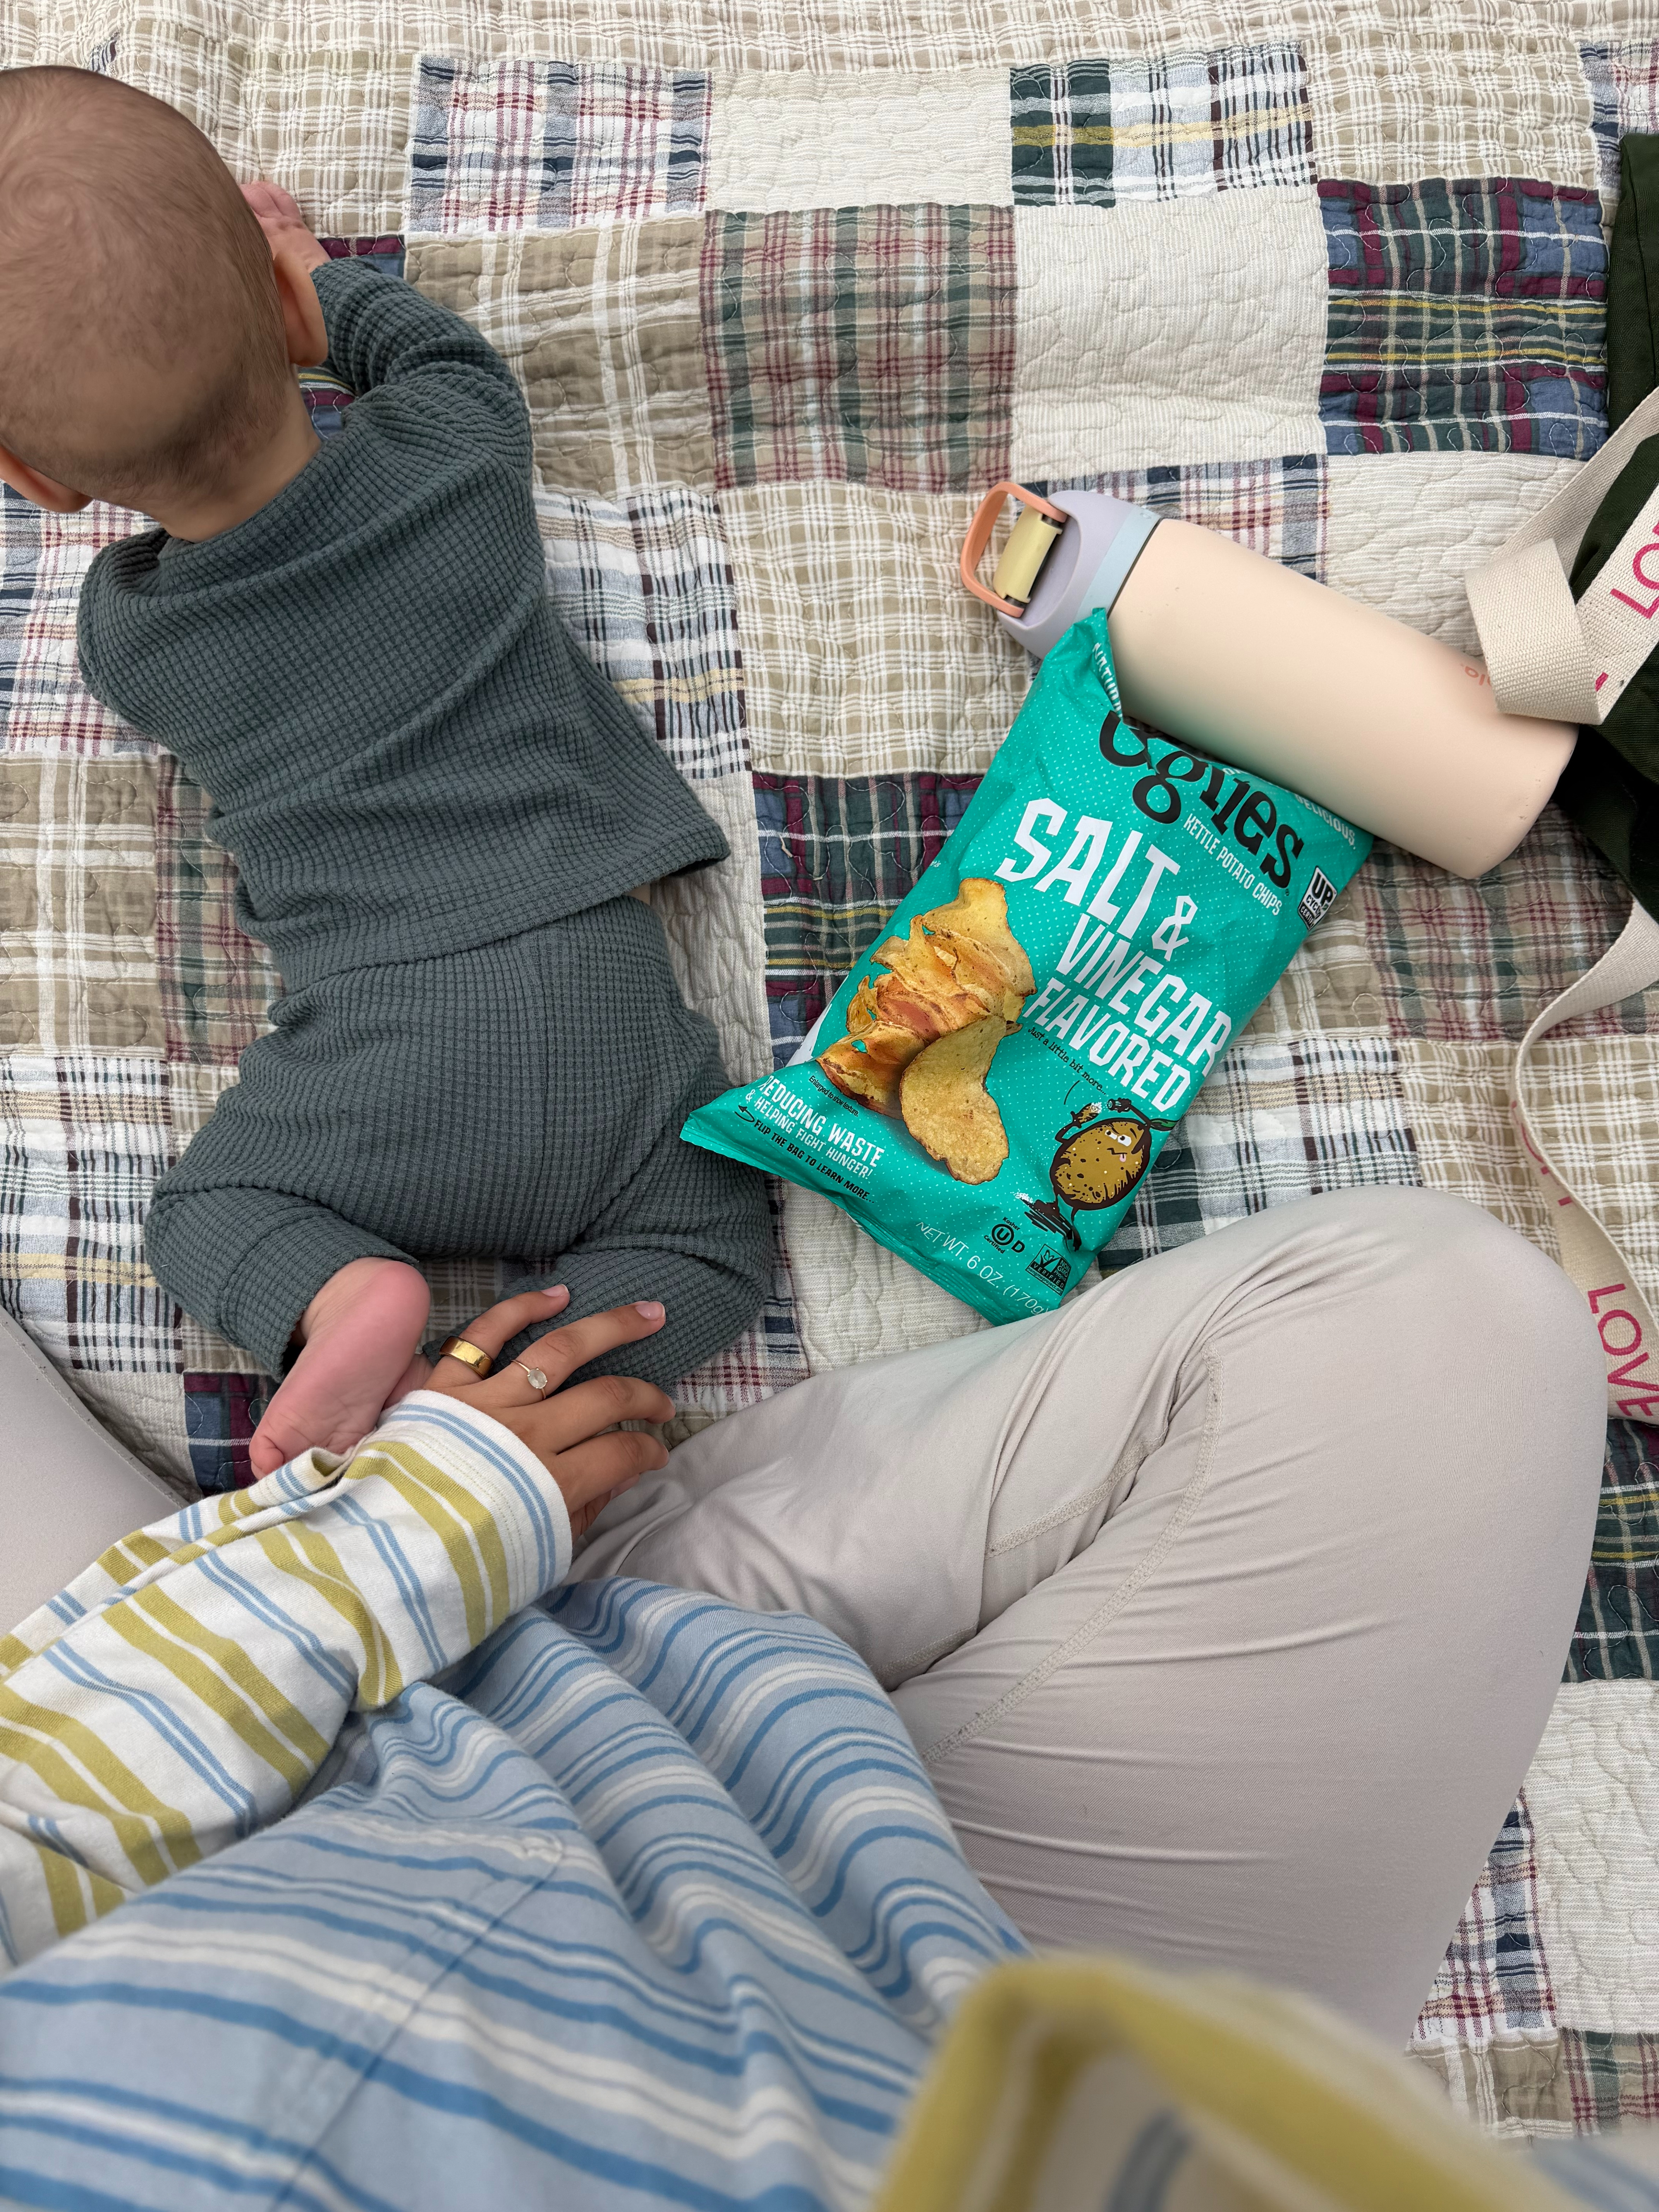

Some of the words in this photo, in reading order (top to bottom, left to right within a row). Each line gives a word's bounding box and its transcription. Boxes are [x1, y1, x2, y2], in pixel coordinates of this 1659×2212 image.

[994, 798, 1180, 939] SALT
[1151, 895, 1198, 961] &
[1183, 813, 1221, 855] KETTLE
[1216, 846, 1255, 890] POTATO
[1252, 882, 1283, 916] CHIPS
[1312, 872, 1333, 907] UP
[1056, 914, 1231, 1077] VINEGAR
[1022, 978, 1190, 1112] FLAVORED
[1028, 1027, 1045, 1041] Just
[1048, 1042, 1069, 1063] little
[1069, 1059, 1084, 1073] bit
[1081, 1071, 1106, 1095] more...
[809, 1075, 830, 1095] Enlarged
[833, 1096, 844, 1106] show
[842, 1102, 859, 1117] texture.
[745, 1089, 756, 1102] &
[754, 1096, 795, 1134] HELPING
[795, 1128, 826, 1152] FIGHT
[825, 1146, 873, 1180] HUNGER!
[828, 1123, 885, 1168] WASTE
[754, 1119, 771, 1135] FLIP
[771, 1132, 788, 1147] THE
[786, 1143, 805, 1159] BAG
[805, 1155, 817, 1166] TO
[816, 1163, 845, 1184] LEARN
[843, 1180, 875, 1204] MORE...
[984, 1235, 1006, 1254] Certified
[1002, 1217, 1021, 1231] Kosher
[1011, 1240, 1025, 1253] D
[916, 1222, 946, 1243] NET
[943, 1235, 969, 1260] WT.
[967, 1255, 981, 1269] 6
[979, 1265, 1003, 1288] OZ.
[1033, 1264, 1064, 1288] VERIFIED
[1057, 1266, 1069, 1278] GMO
[1060, 1259, 1070, 1272] NON
